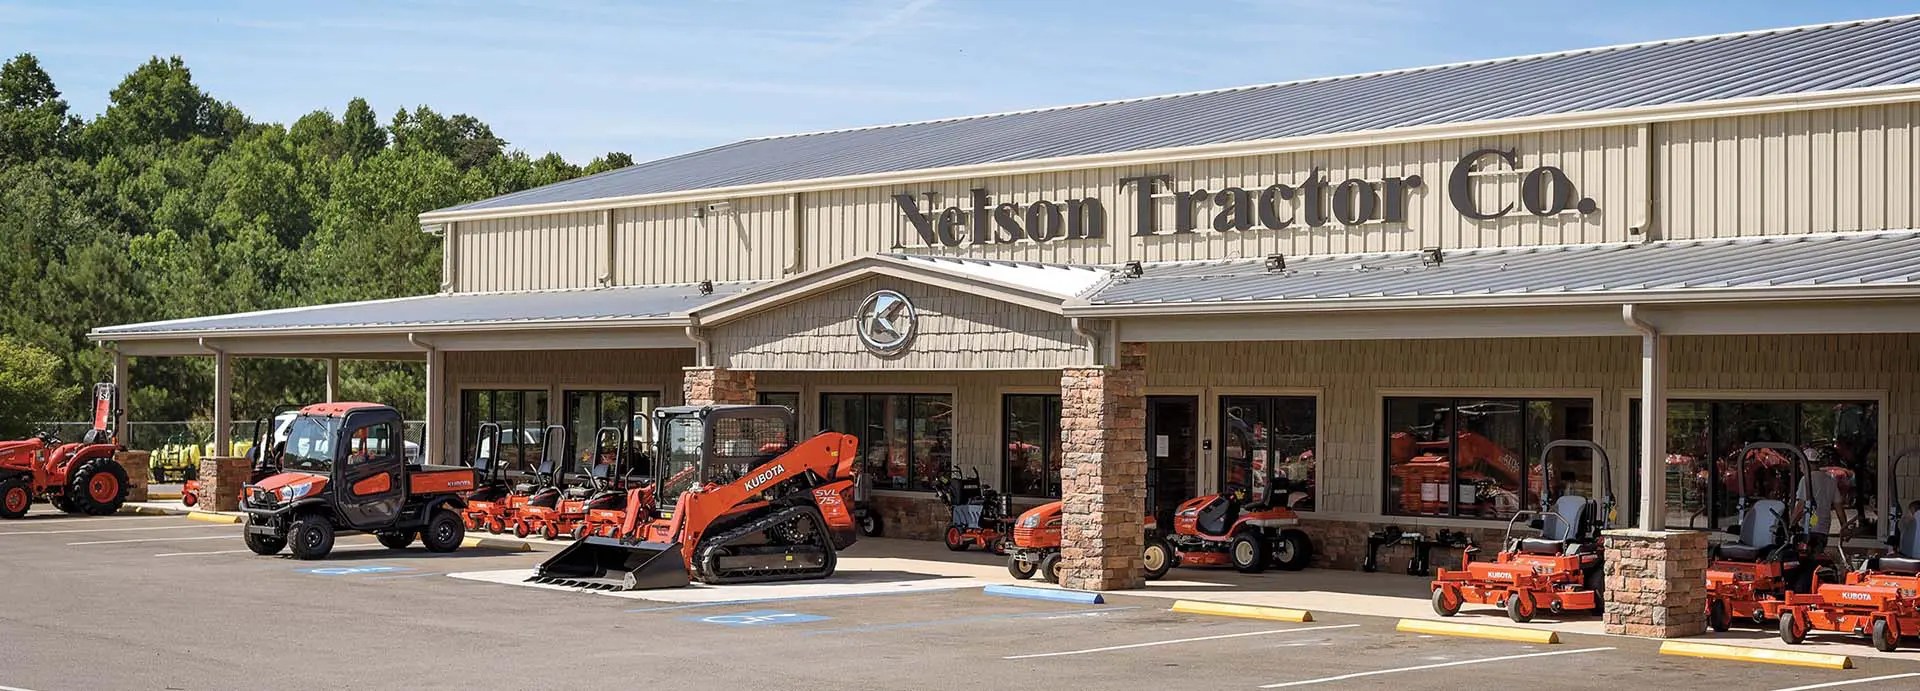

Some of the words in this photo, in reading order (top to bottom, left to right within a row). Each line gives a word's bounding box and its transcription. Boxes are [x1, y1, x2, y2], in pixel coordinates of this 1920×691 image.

[891, 188, 1107, 250] Nelson
[1119, 166, 1422, 237] Tractor
[1448, 147, 1597, 220] Co.
[744, 464, 785, 491] KUBOTA
[815, 489, 840, 497] SVL
[1487, 571, 1512, 579] KUBOTA
[1842, 592, 1872, 600] KUBOTA
